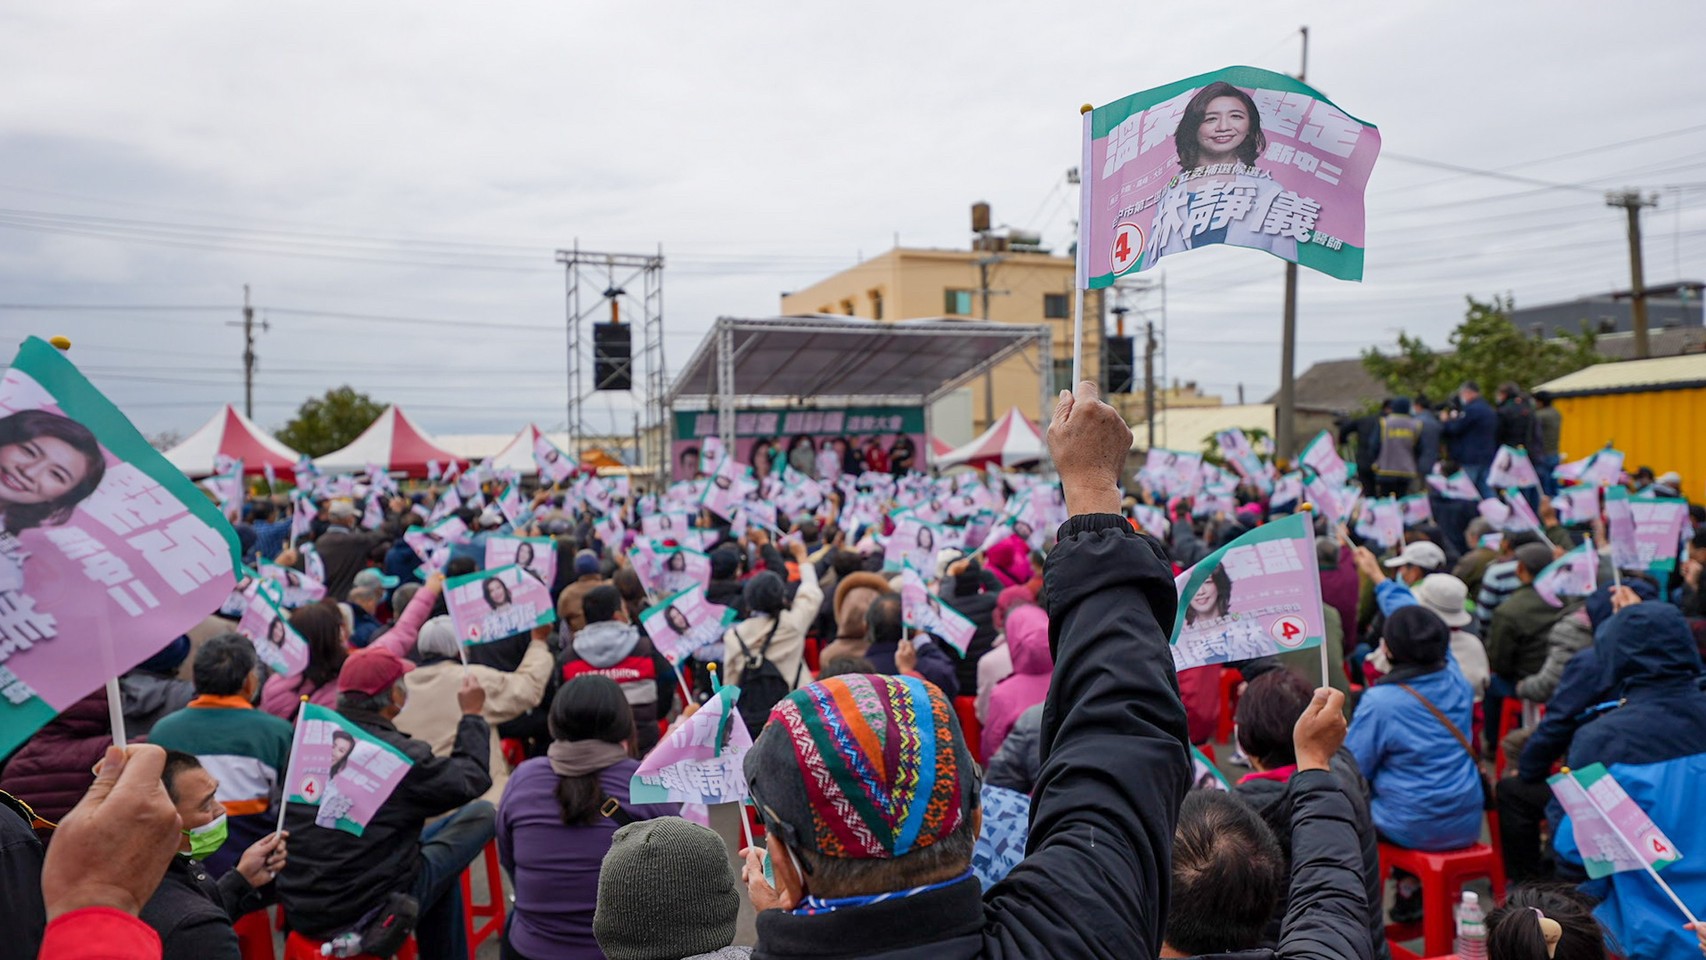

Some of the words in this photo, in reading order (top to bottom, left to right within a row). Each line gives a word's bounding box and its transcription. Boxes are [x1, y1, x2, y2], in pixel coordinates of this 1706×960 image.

[1263, 142, 1343, 186] 新中二
[1115, 232, 1131, 262] 4
[1312, 230, 1344, 251] 醫師
[43, 526, 160, 617] 新中二
